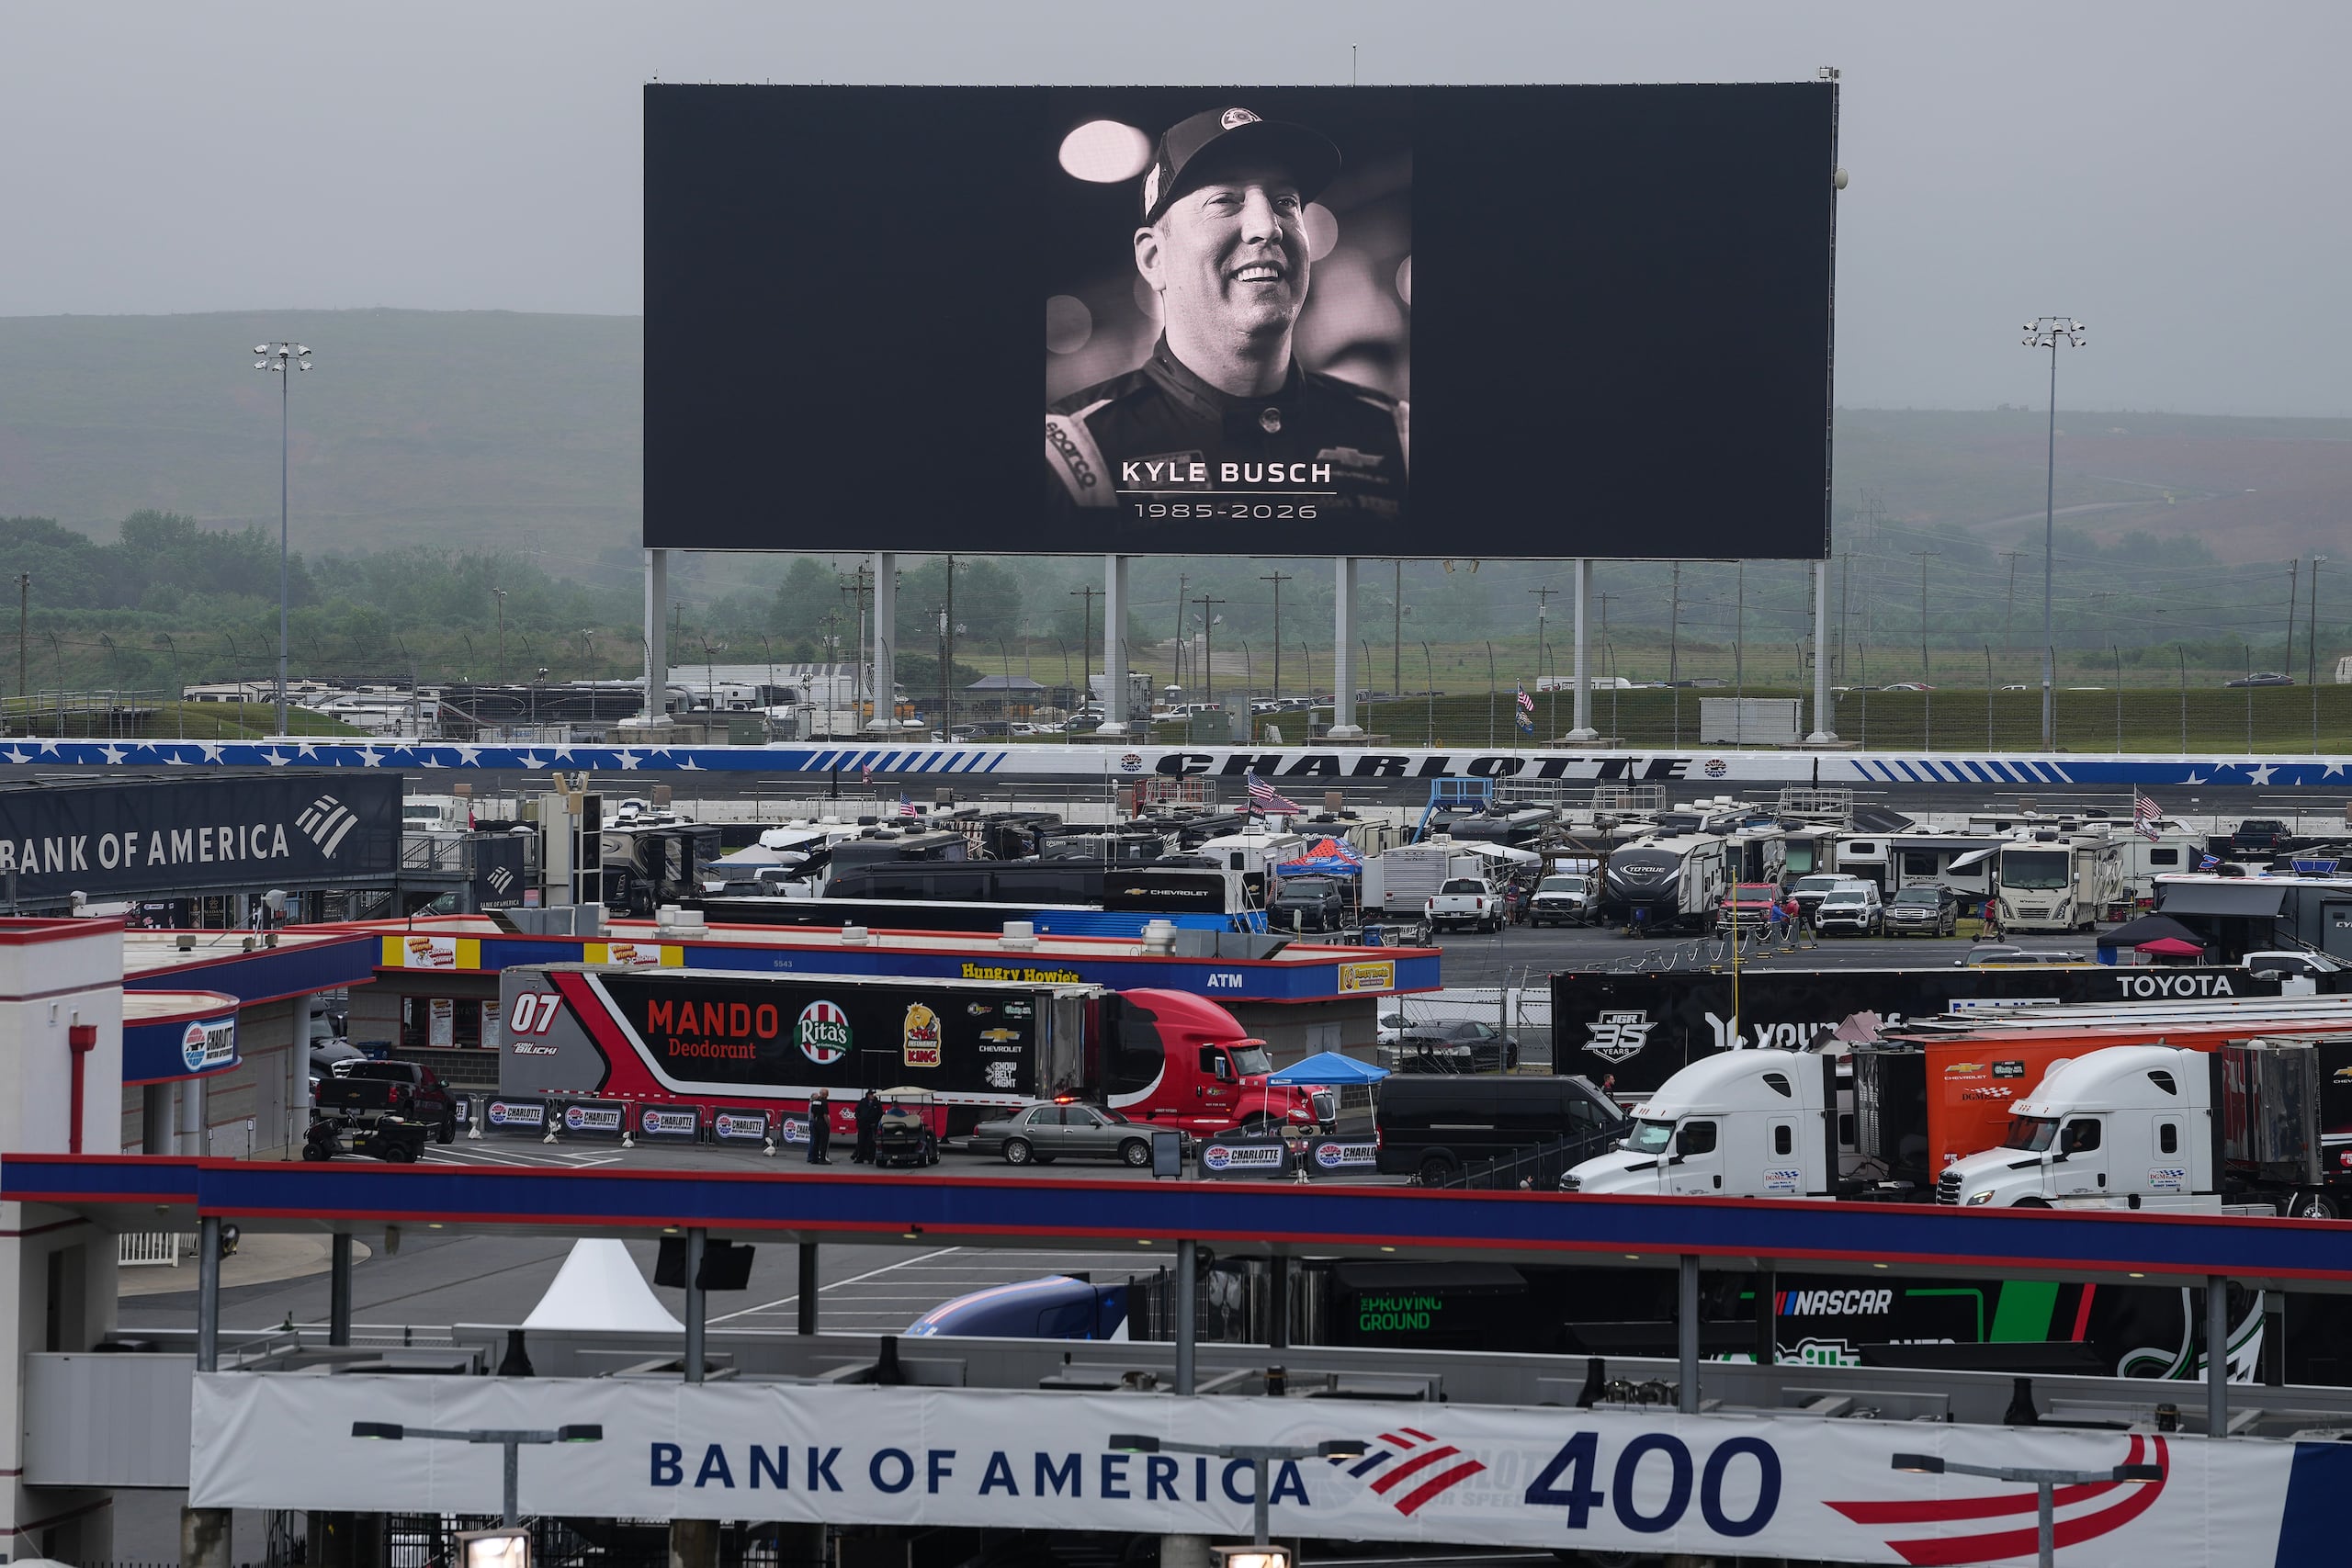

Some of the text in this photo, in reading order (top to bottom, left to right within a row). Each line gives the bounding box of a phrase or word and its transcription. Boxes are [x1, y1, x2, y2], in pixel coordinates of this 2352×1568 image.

[1122, 461, 1206, 482] KYLE
[1221, 462, 1330, 483] BUSCH
[1135, 503, 1317, 519] 1985-2026
[1155, 754, 1692, 780] CHARLOTTE
[0, 823, 289, 874] BANK OF AMERICA
[774, 960, 793, 968] 5543
[961, 963, 1080, 983] Hungry Howie's
[1207, 974, 1243, 987] ATM
[2116, 976, 2233, 997] TOYOTA
[510, 992, 562, 1033] 07
[648, 999, 778, 1039] MANDO
[1606, 1014, 1638, 1023] JGR
[801, 1019, 847, 1044] Rita's
[1585, 1024, 1655, 1049] 35
[514, 1046, 558, 1055] BILICKI
[668, 1038, 756, 1059] Deodorant
[908, 1050, 937, 1063] KING
[994, 1062, 1017, 1071] SNOW
[994, 1071, 1012, 1079] BELT
[993, 1079, 1016, 1089] MGMT
[507, 1108, 541, 1119] CHARLOTTE
[583, 1111, 618, 1122] CHARLOTTE
[661, 1115, 693, 1126] CHARLOTTE
[732, 1120, 762, 1131] CHARLOTTE
[1231, 1149, 1279, 1160] CHARLOTTE
[1343, 1147, 1376, 1157] CHARLO
[1369, 1296, 1442, 1312] PROVING
[1792, 1289, 1894, 1315] NASCAR
[1360, 1312, 1430, 1331] GROUND
[650, 1431, 1782, 1538] BANK OF AMERICA 400
